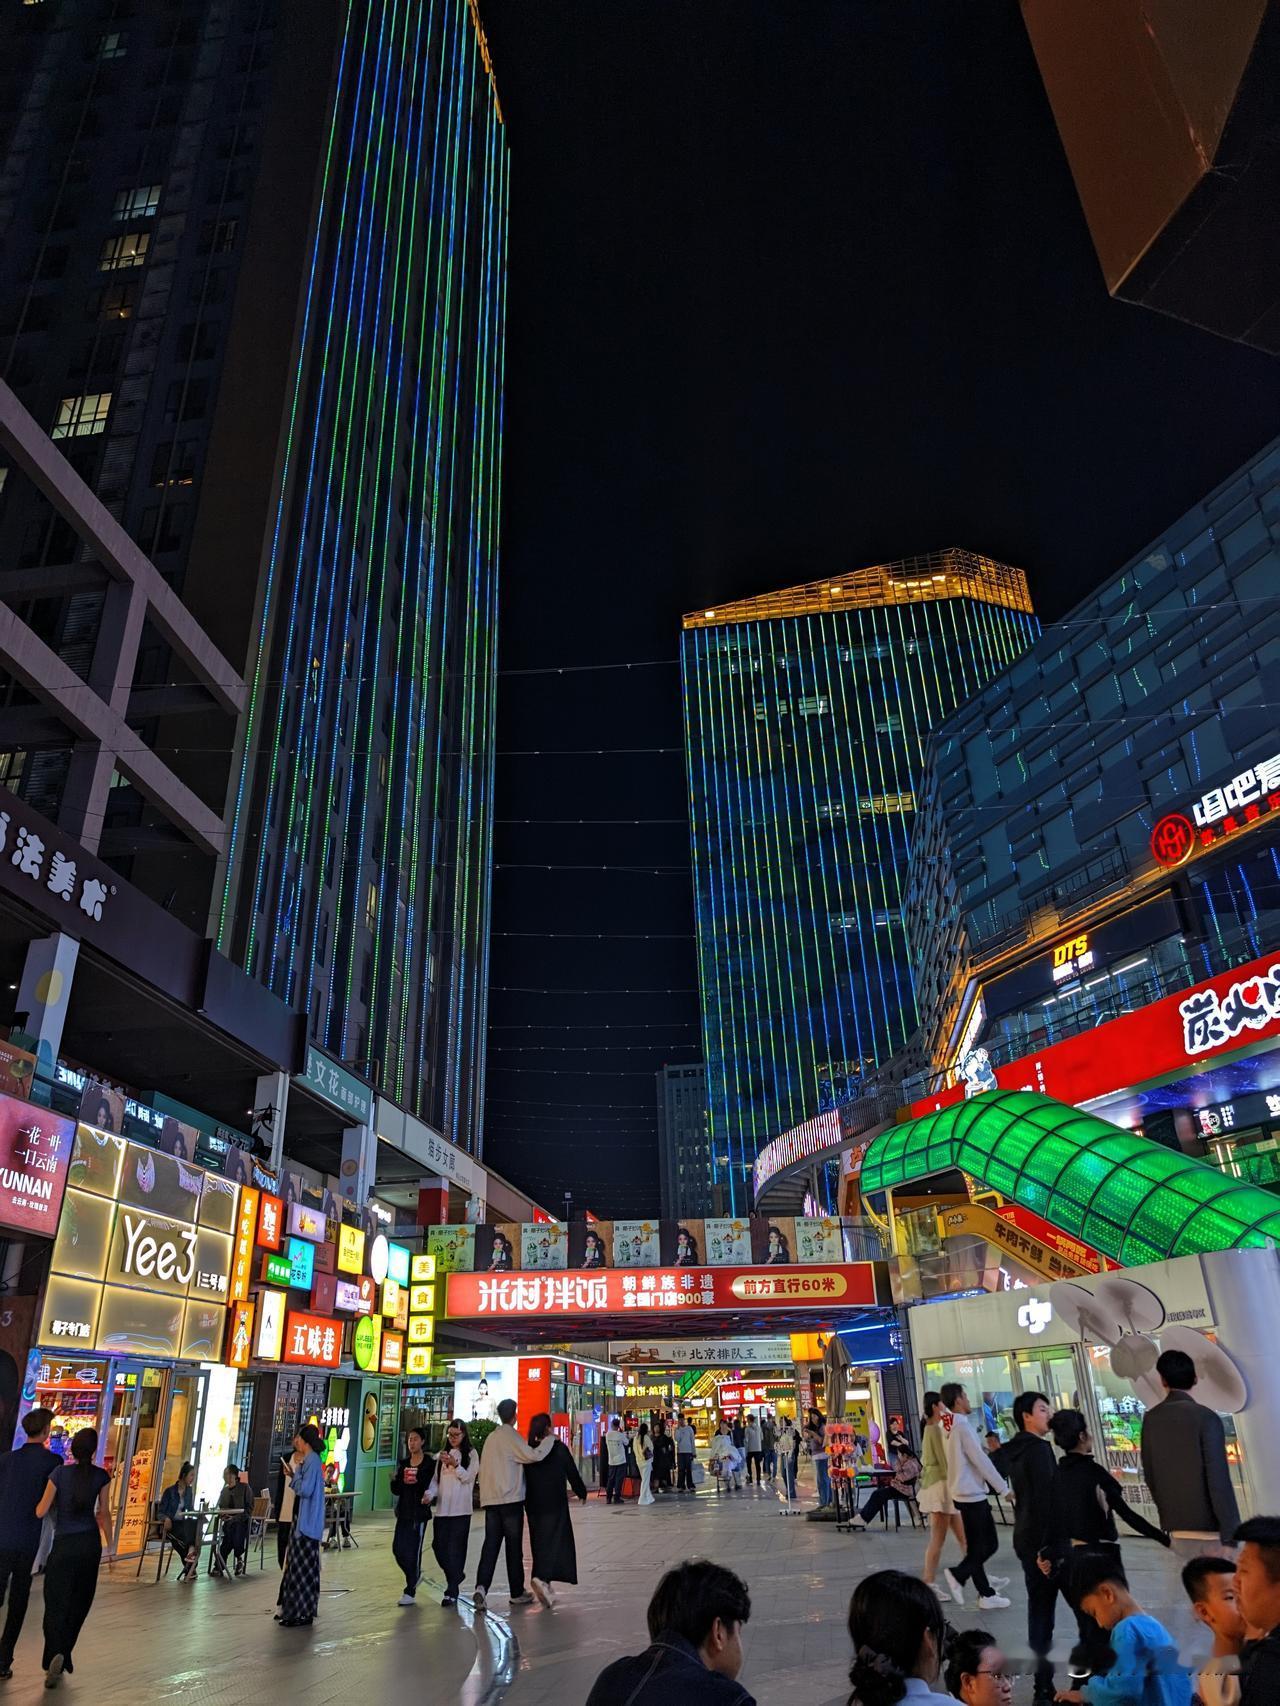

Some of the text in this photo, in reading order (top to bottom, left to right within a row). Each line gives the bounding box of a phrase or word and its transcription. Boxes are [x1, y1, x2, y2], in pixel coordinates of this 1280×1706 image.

[1053, 934, 1088, 967] DTS
[1179, 963, 1280, 1055] 炭火
[18, 1126, 62, 1152] 一花一叶
[124, 1214, 198, 1284] Yee3
[994, 1221, 1044, 1263] 牛肉不鲜
[478, 1275, 608, 1311] 米村拌饭
[622, 1273, 715, 1290] 朝鲜族非遗
[744, 1277, 836, 1294] 前方直行60米
[622, 1291, 715, 1307] 全国门店900家
[290, 1323, 335, 1361] 五味巷
[689, 1346, 757, 1361] 北京排队王
